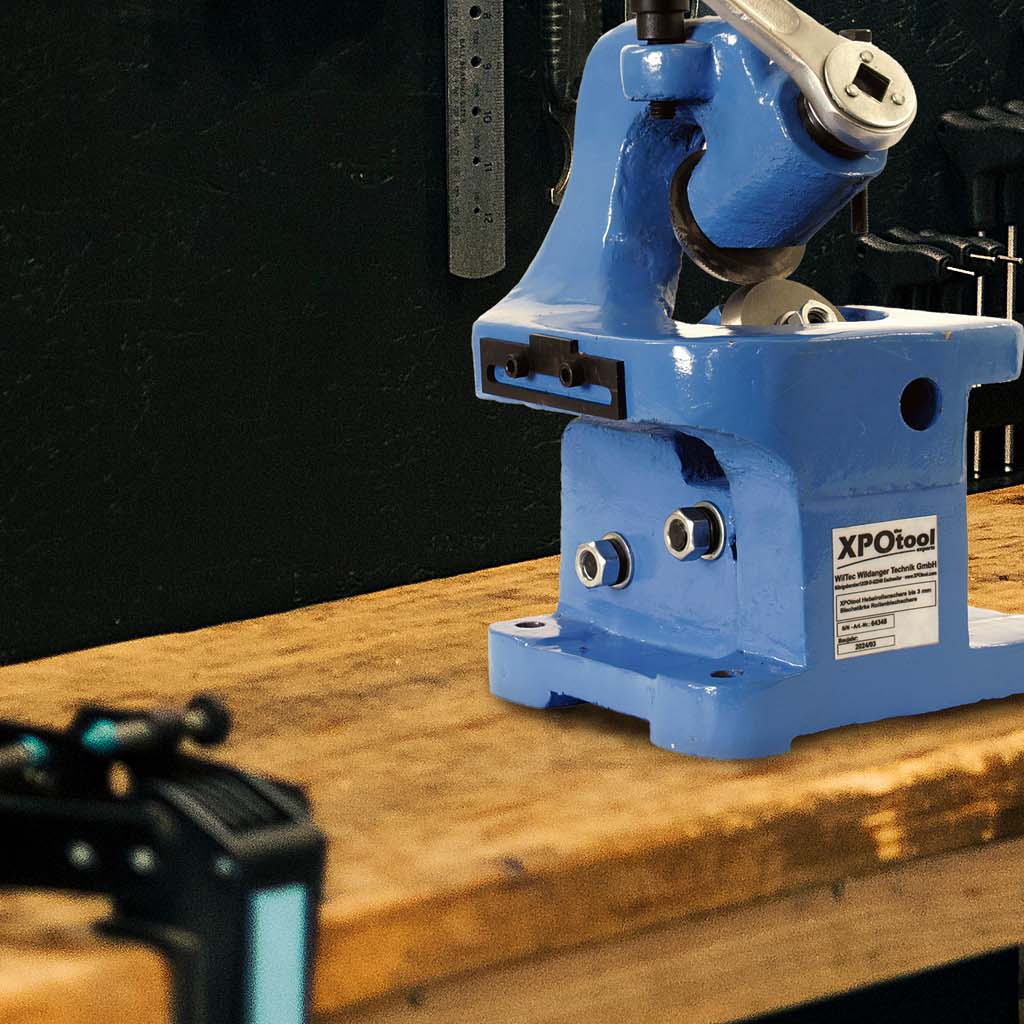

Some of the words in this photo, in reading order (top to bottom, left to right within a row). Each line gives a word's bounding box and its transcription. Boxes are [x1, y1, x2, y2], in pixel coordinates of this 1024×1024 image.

[483, 110, 493, 124] 10
[856, 568, 890, 580] Wildanger
[890, 564, 915, 574] Technik
[916, 560, 937, 570] GmbH
